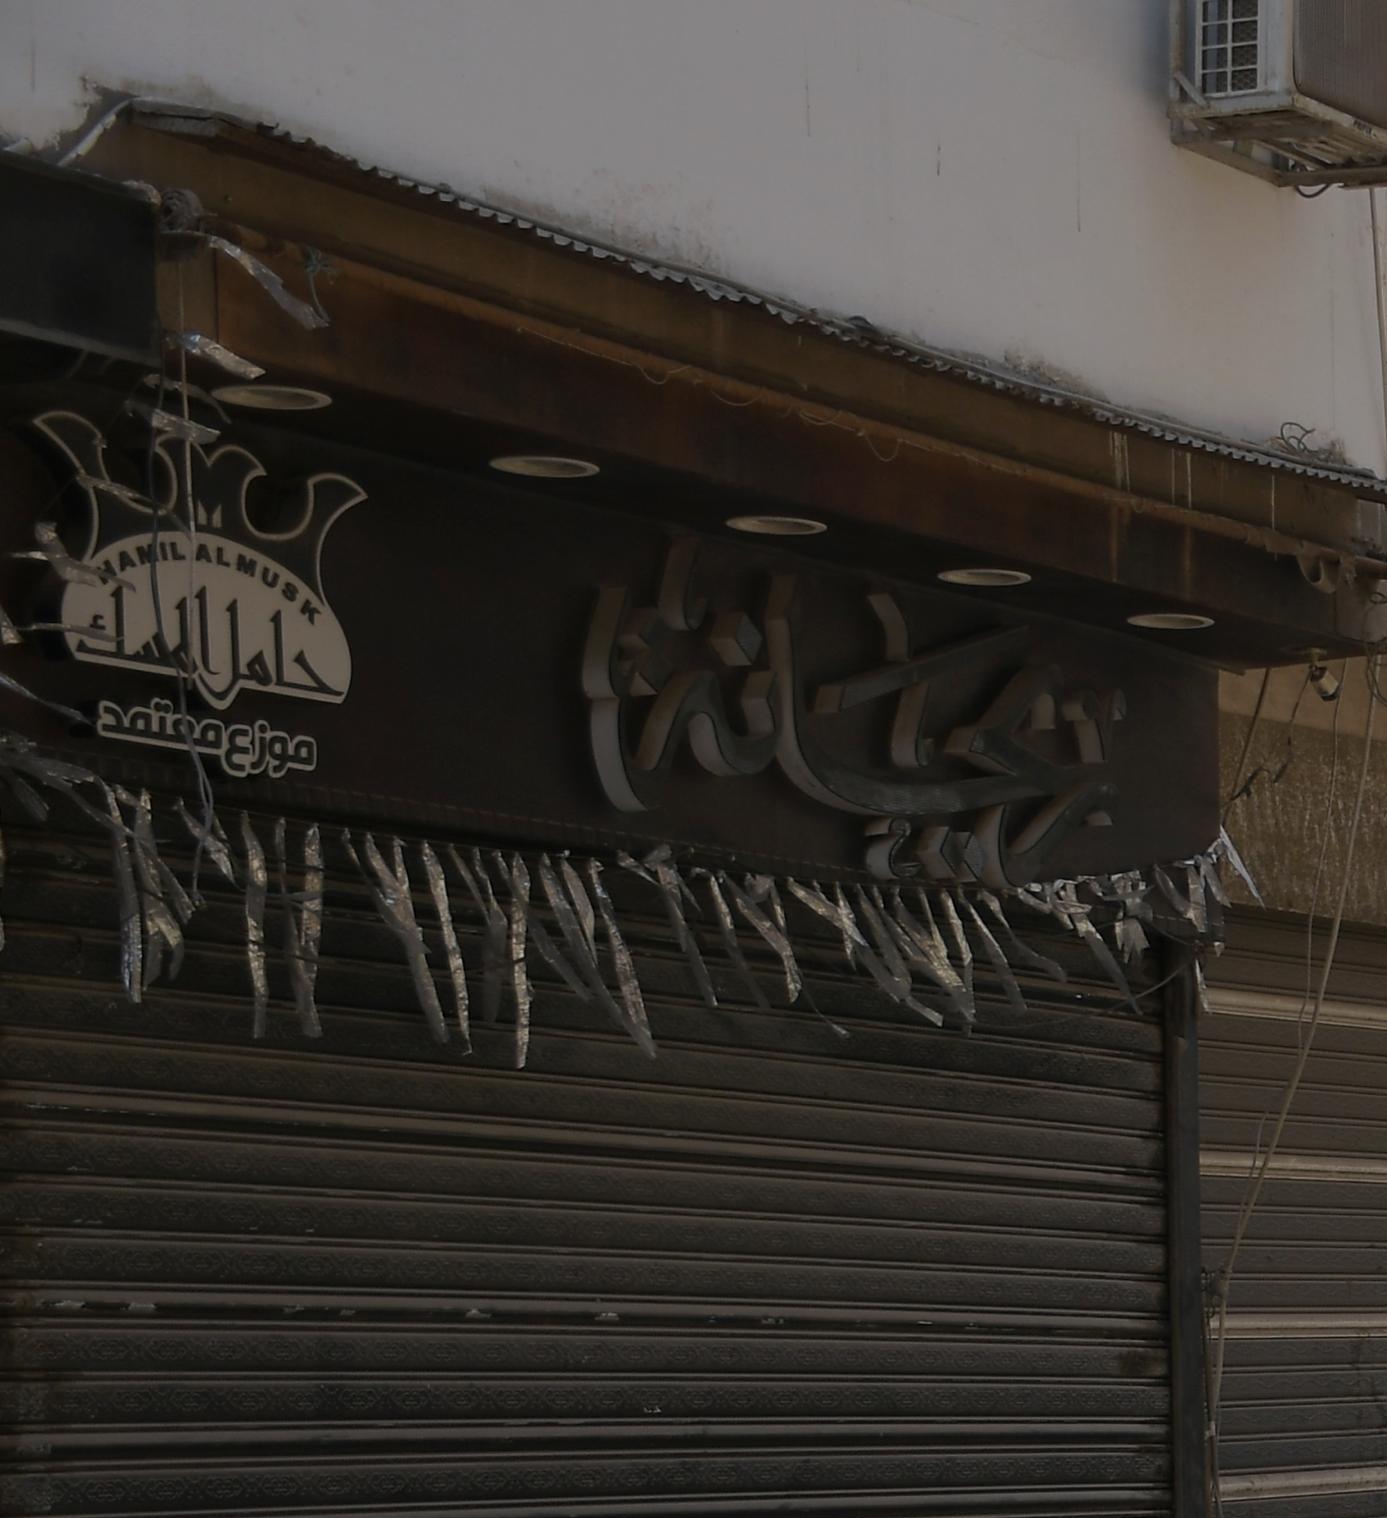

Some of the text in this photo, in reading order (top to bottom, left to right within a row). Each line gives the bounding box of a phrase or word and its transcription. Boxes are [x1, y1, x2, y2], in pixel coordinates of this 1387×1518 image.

[195, 544, 322, 625] ALMUSK
[76, 584, 346, 700] حامل المسك
[97, 697, 318, 777] موزع معتمد
